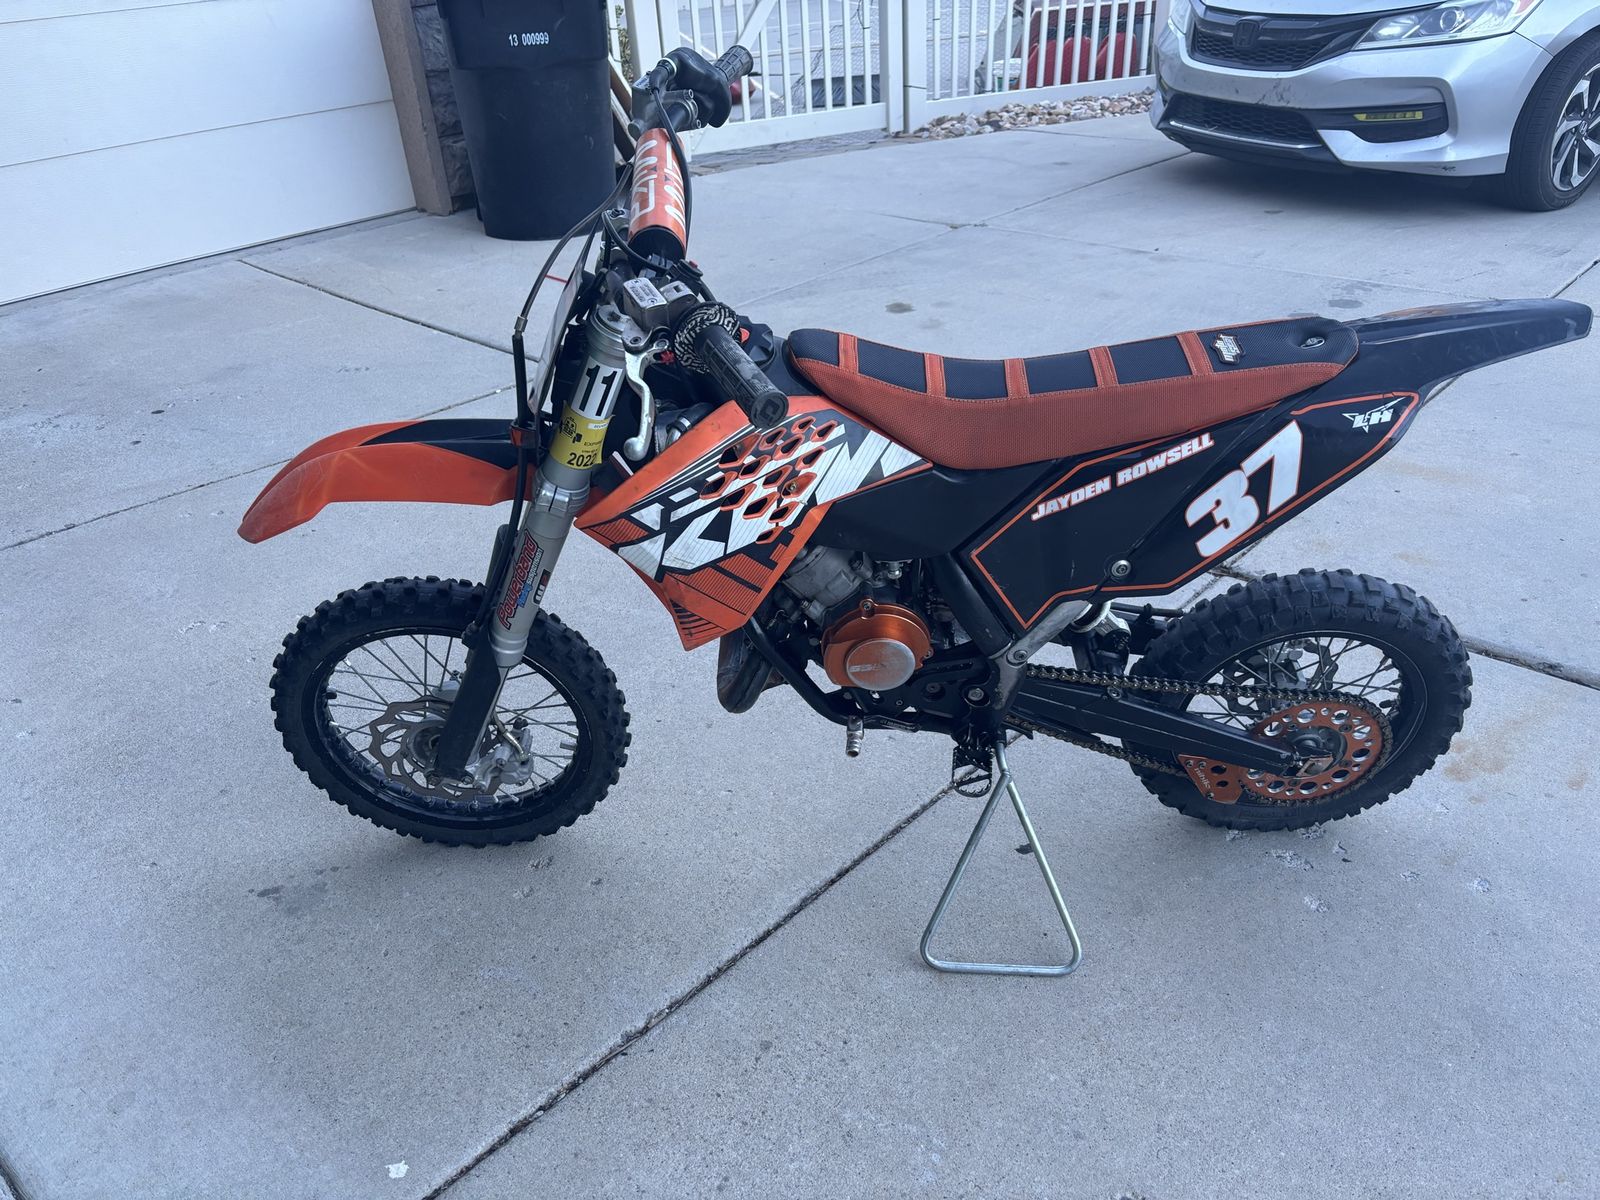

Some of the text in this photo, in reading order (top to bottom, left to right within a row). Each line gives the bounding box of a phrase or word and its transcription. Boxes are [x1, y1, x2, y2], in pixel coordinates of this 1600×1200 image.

[508, 33, 519, 47] 13
[578, 364, 619, 417] 11
[1031, 432, 1215, 522] JAYDEN ROWSELL
[1185, 420, 1303, 558] 37
